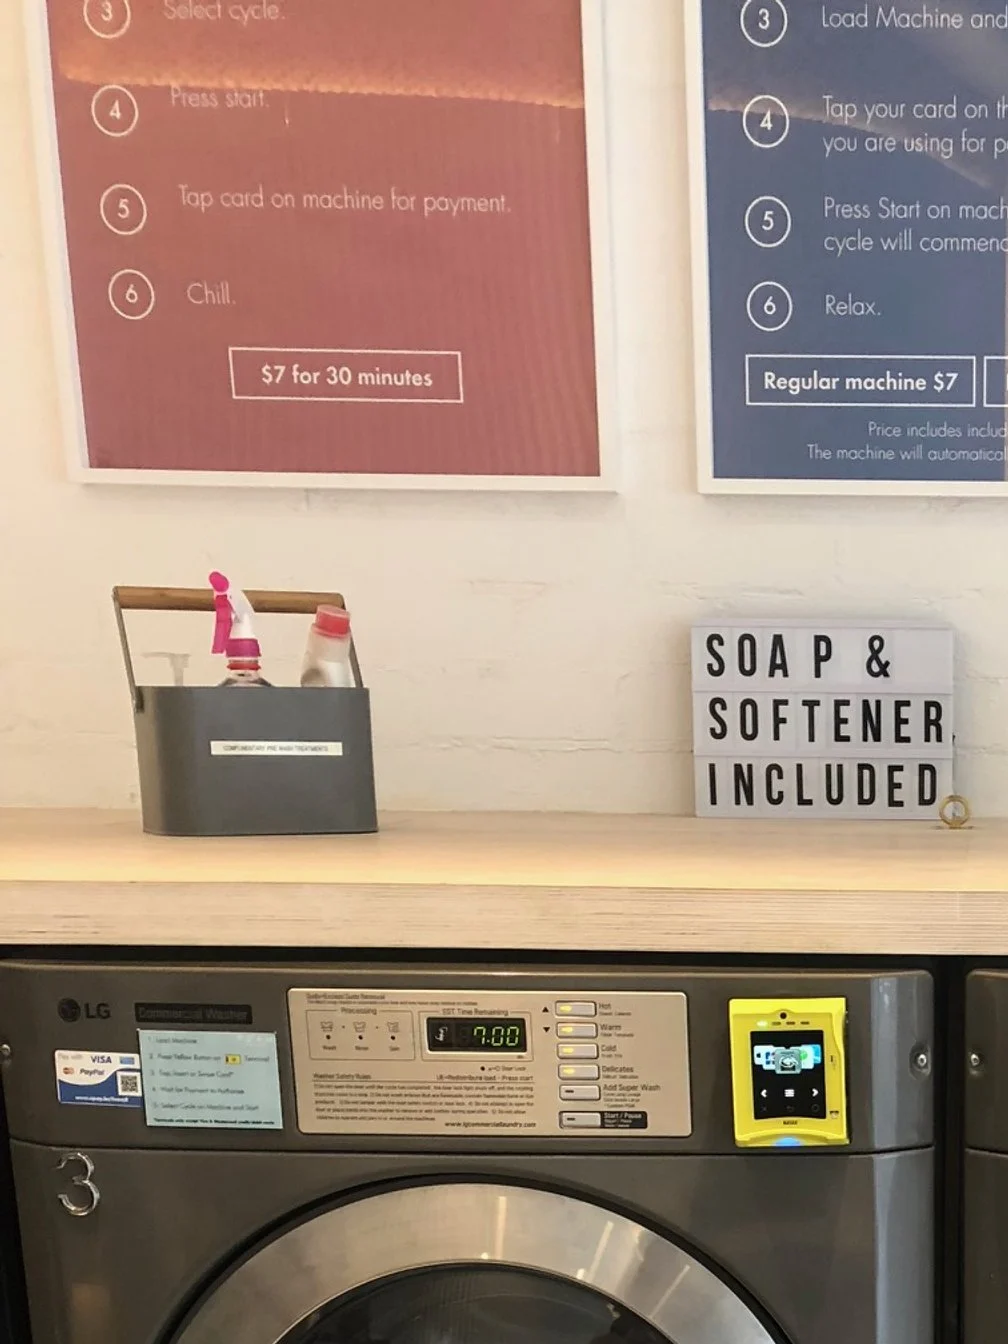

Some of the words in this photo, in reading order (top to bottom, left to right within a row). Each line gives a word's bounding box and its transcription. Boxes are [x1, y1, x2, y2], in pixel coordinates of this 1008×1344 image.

[101, 2, 112, 21] 3
[164, 0, 221, 20] Select
[229, 0, 286, 27] cycle.
[758, 9, 770, 30] 3
[822, 5, 868, 29] Load
[876, 5, 963, 30] Machine
[970, 5, 1008, 30] and
[109, 99, 121, 120] 4
[170, 85, 218, 108] Press
[225, 89, 270, 109] start.
[759, 110, 773, 132] 4
[822, 94, 857, 127] Tap
[863, 102, 904, 127] your
[913, 95, 957, 120] card
[963, 101, 988, 120] on
[822, 134, 857, 162] you
[864, 135, 897, 153] are
[903, 131, 954, 158] using
[960, 129, 985, 153] for
[118, 199, 129, 219] 5
[178, 183, 213, 214] Tap
[220, 184, 263, 209] card
[271, 191, 295, 209] on
[303, 184, 384, 211] machine
[391, 187, 415, 211] for
[424, 193, 512, 218] payment.
[761, 211, 774, 231] 5
[824, 196, 871, 219] Press
[878, 197, 920, 219] Start
[927, 203, 951, 220] on
[824, 228, 873, 257] cycle
[880, 229, 912, 251] will
[125, 284, 138, 303] 6
[187, 280, 236, 305] Chill.
[764, 296, 776, 315] 6
[825, 293, 881, 316] Relax.
[262, 361, 286, 385] $7
[292, 363, 320, 385] for
[326, 366, 351, 385] 30
[358, 367, 433, 387] minutes
[764, 372, 840, 395] Regular
[845, 373, 927, 392] machine
[933, 372, 959, 395] $7
[868, 421, 901, 438] Price
[907, 422, 962, 439] includes
[807, 444, 831, 460] The
[836, 445, 895, 460] machine
[900, 444, 923, 461] will
[706, 633, 832, 678] SOAP
[865, 634, 891, 678] &
[708, 697, 943, 743] SOFTENER
[708, 763, 937, 807] INCLUDED
[85, 1003, 111, 1019] LG
[80, 1068, 104, 1076] PayPal
[91, 1056, 112, 1064] VISA
[56, 1152, 100, 1216] 3
